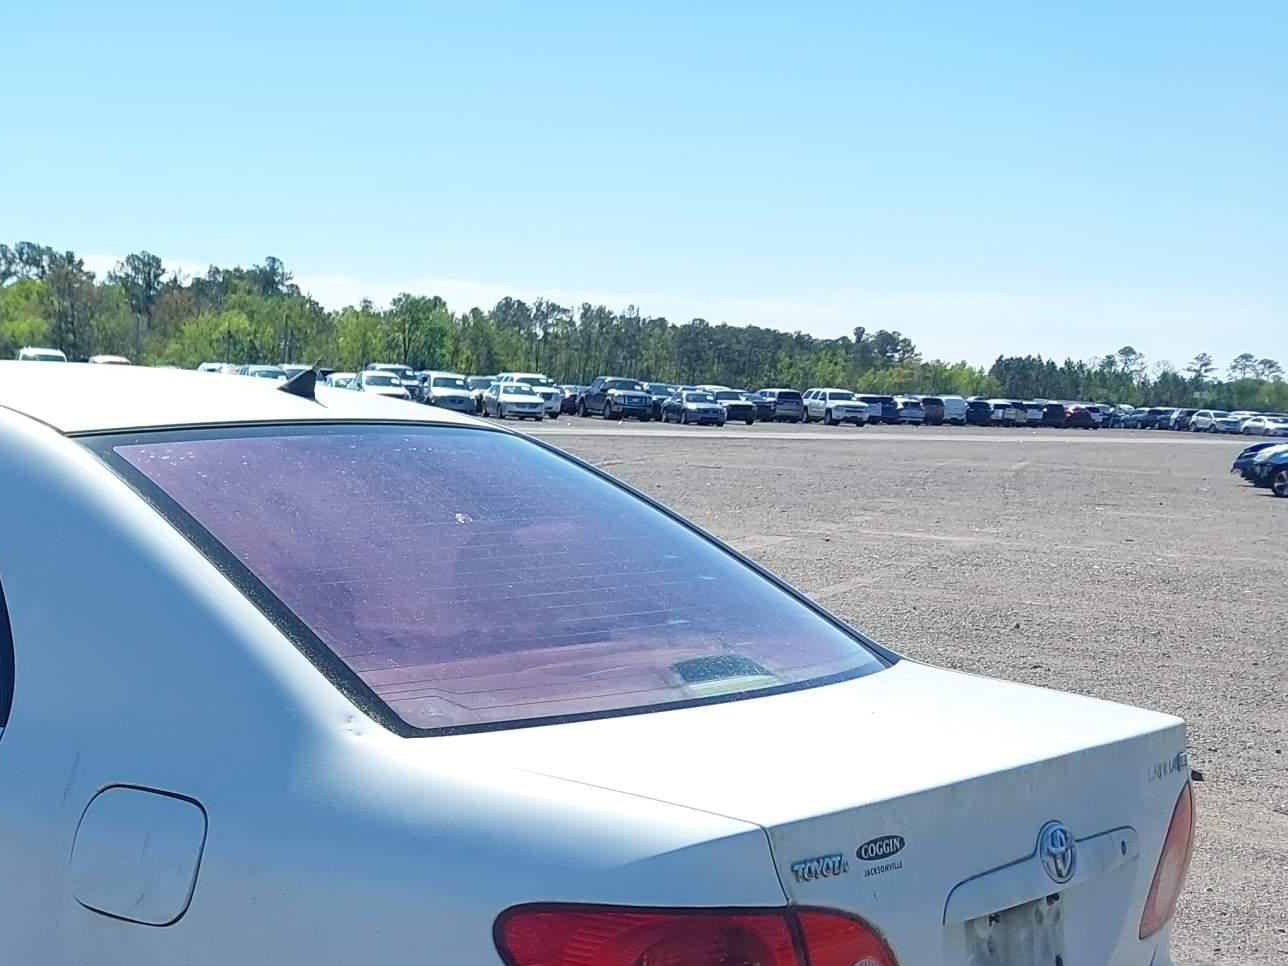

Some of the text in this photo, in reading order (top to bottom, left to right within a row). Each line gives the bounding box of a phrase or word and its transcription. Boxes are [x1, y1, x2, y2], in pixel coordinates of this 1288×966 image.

[860, 837, 901, 860] COGGIN
[791, 854, 849, 883] TOYOTA
[864, 860, 903, 878] JACKSONVILLE
